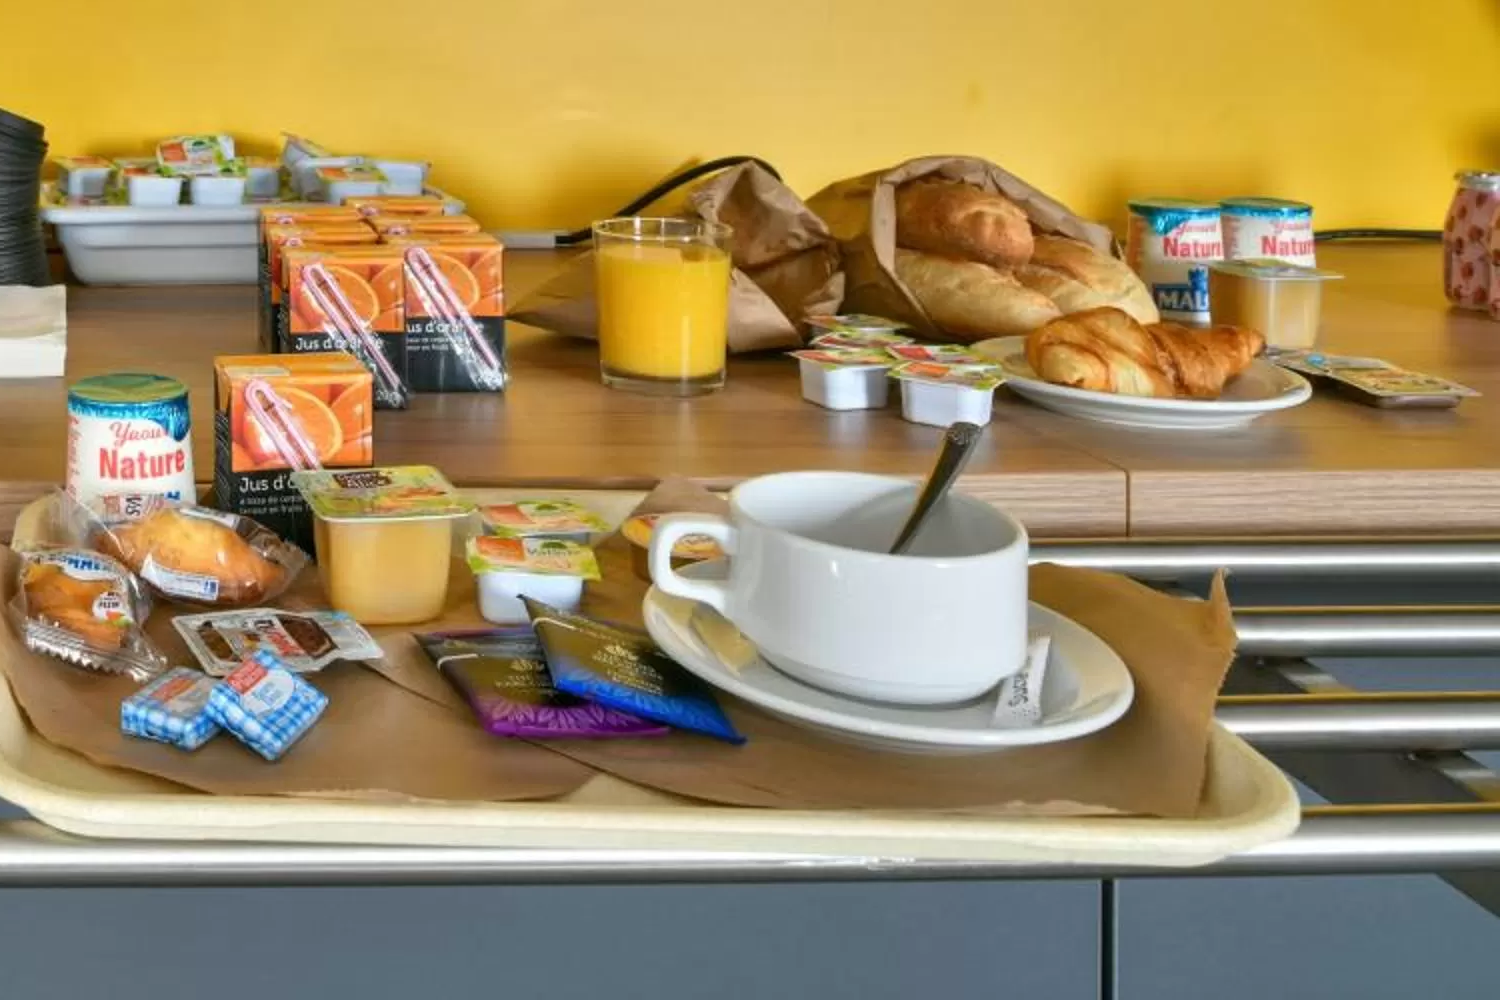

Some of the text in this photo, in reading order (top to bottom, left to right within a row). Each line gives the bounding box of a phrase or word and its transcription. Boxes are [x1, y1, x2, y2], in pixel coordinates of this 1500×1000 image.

[1163, 236, 1222, 258] Natur
[1260, 234, 1316, 257] Natur
[1158, 287, 1209, 312] MAL
[295, 336, 320, 351] Jus
[109, 420, 168, 448] Yaou
[99, 447, 186, 480] Nature
[239, 476, 269, 493] Jus
